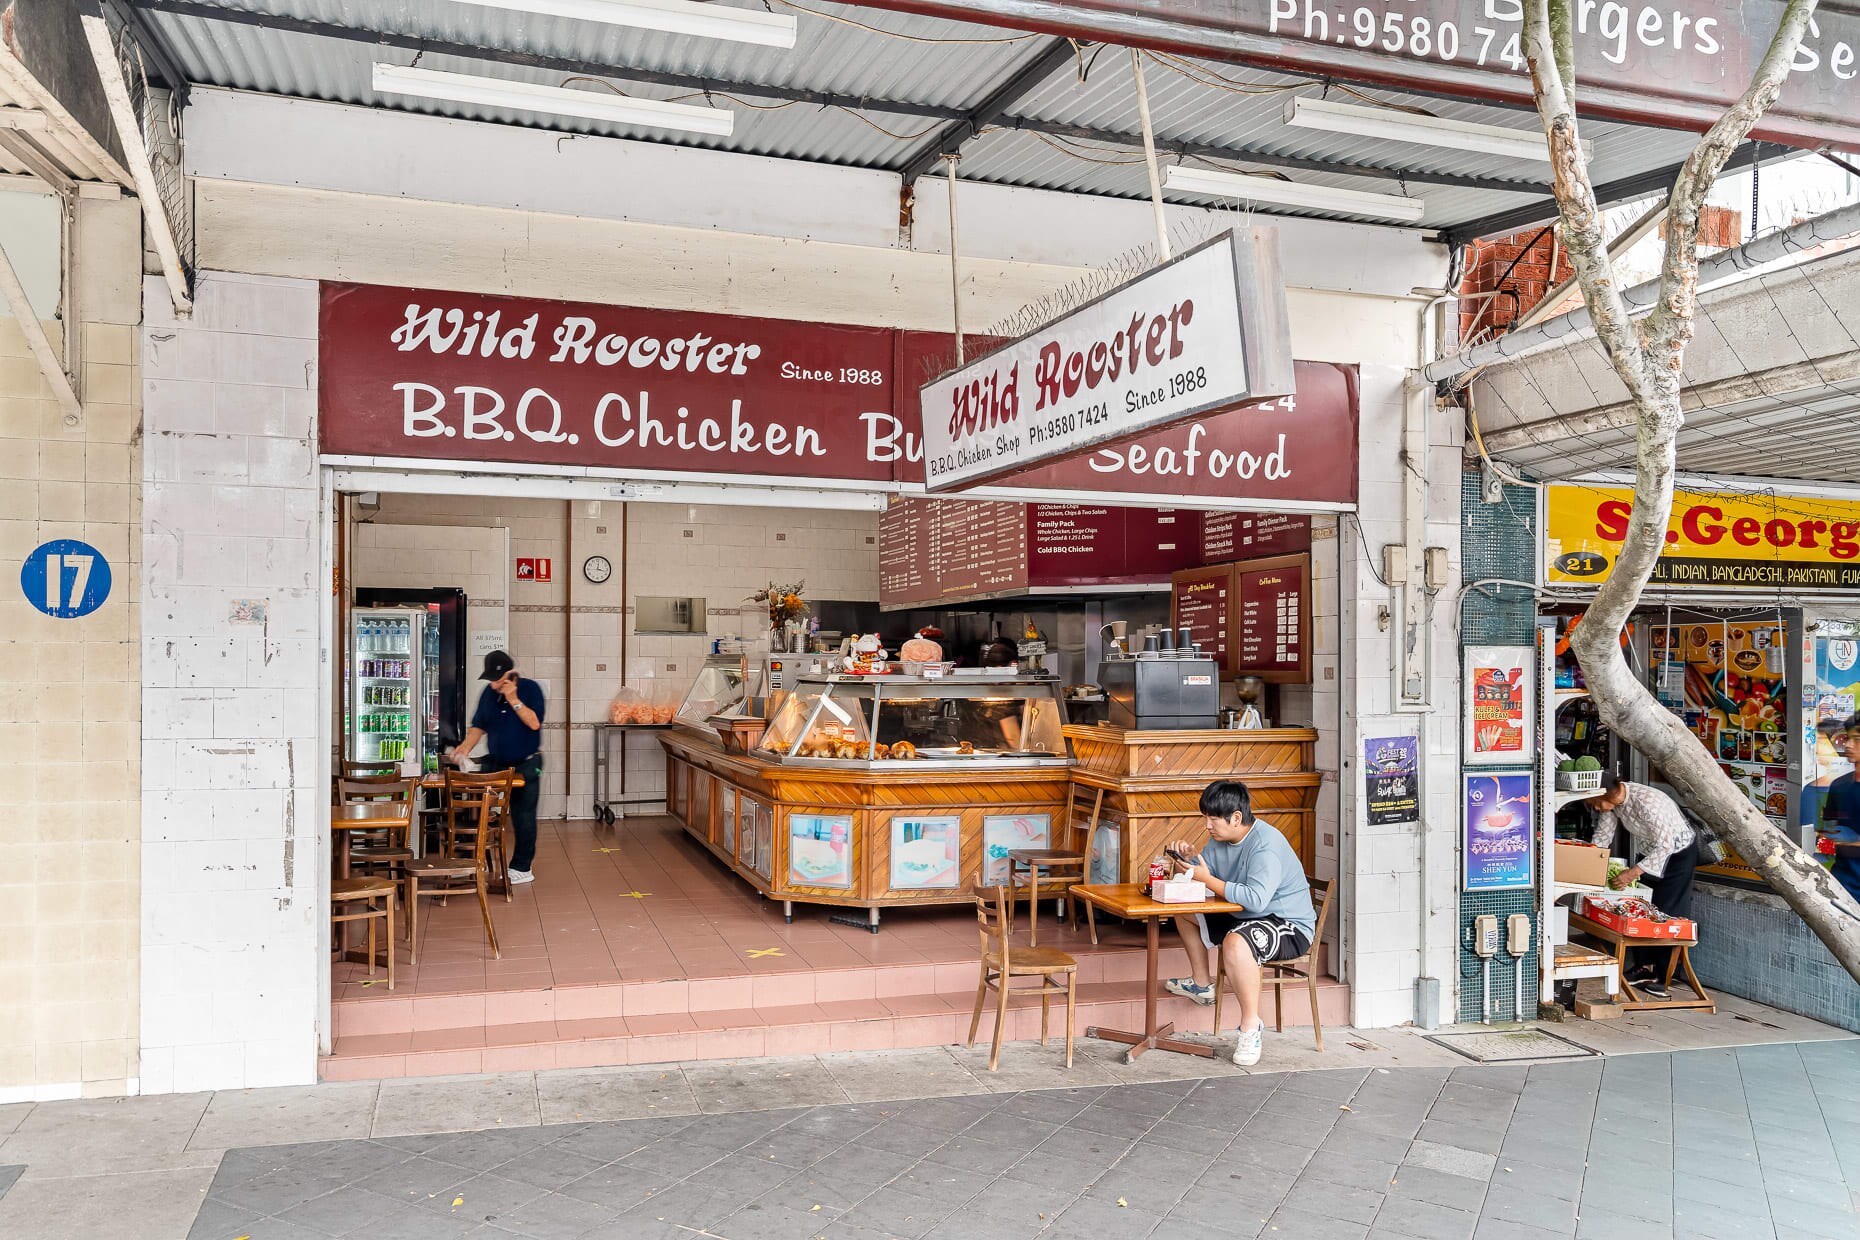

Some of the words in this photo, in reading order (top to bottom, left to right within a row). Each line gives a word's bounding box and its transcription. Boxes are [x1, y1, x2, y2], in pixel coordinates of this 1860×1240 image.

[390, 303, 539, 360] Wild
[549, 316, 761, 375] Rooster
[780, 361, 834, 382] Since
[838, 367, 883, 386] 1988
[949, 359, 1019, 442] Wild
[1035, 298, 1194, 412] Rooster
[393, 382, 579, 445] B.B.Q.
[594, 390, 827, 457] Chicken
[931, 454, 957, 476] B.B.Q.
[957, 444, 992, 468] Chicken
[996, 433, 1020, 456] Shop
[1029, 412, 1075, 446] Ph:9580
[1078, 401, 1109, 427] 7424
[1125, 386, 1166, 414] Since
[1169, 366, 1207, 400] 1988
[1037, 520, 1059, 528] Family
[1059, 519, 1075, 527] Pack
[1595, 500, 1860, 560] S.Georg
[1037, 546, 1052, 554] Cold
[1053, 546, 1067, 554] BBQ
[1068, 545, 1094, 553] Chicken
[1566, 558, 1594, 572] 21
[1650, 563, 1669, 579] ALI,
[1671, 563, 1710, 582] INDIAN,
[1712, 565, 1785, 583] BANGLADESHI,
[1787, 566, 1838, 585] PAKISTANI,
[46, 554, 95, 608] 17
[1487, 712, 1508, 720] CREAM
[1482, 866, 1501, 874] SHEN
[1502, 865, 1517, 873] YUN
